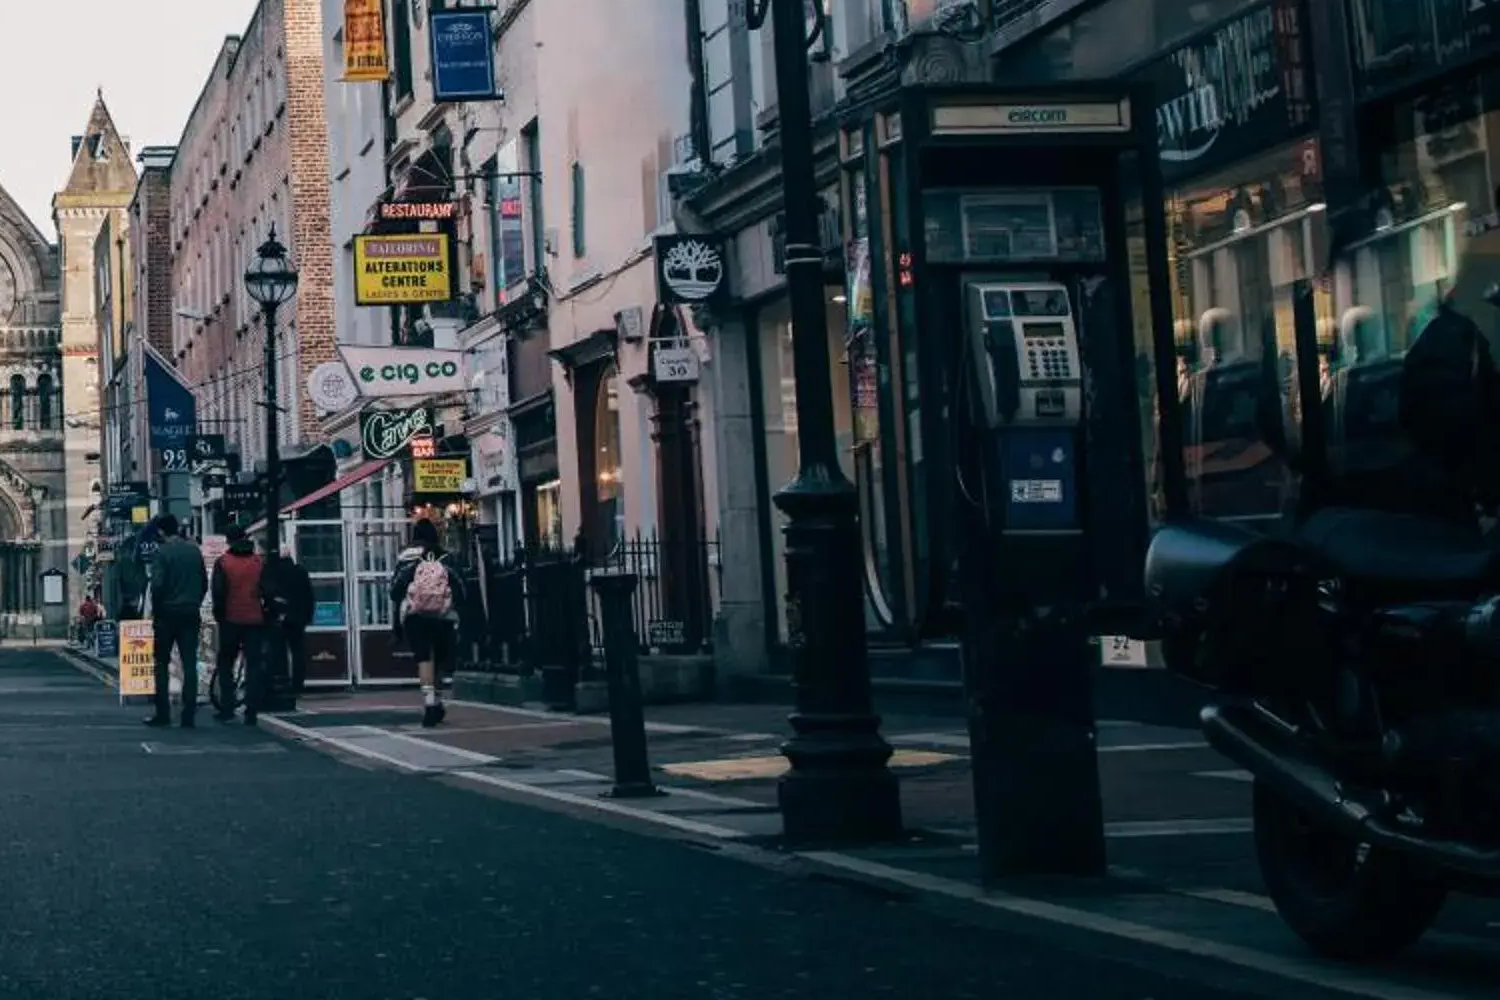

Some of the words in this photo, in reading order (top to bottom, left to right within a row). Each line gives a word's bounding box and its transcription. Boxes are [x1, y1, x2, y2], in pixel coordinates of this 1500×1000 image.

[381, 203, 453, 218] RESTAURANT
[365, 261, 444, 274] ALTERATIONS
[381, 276, 428, 288] CENTRE
[381, 363, 419, 384] cig
[426, 361, 457, 377] co
[163, 449, 190, 472] 22
